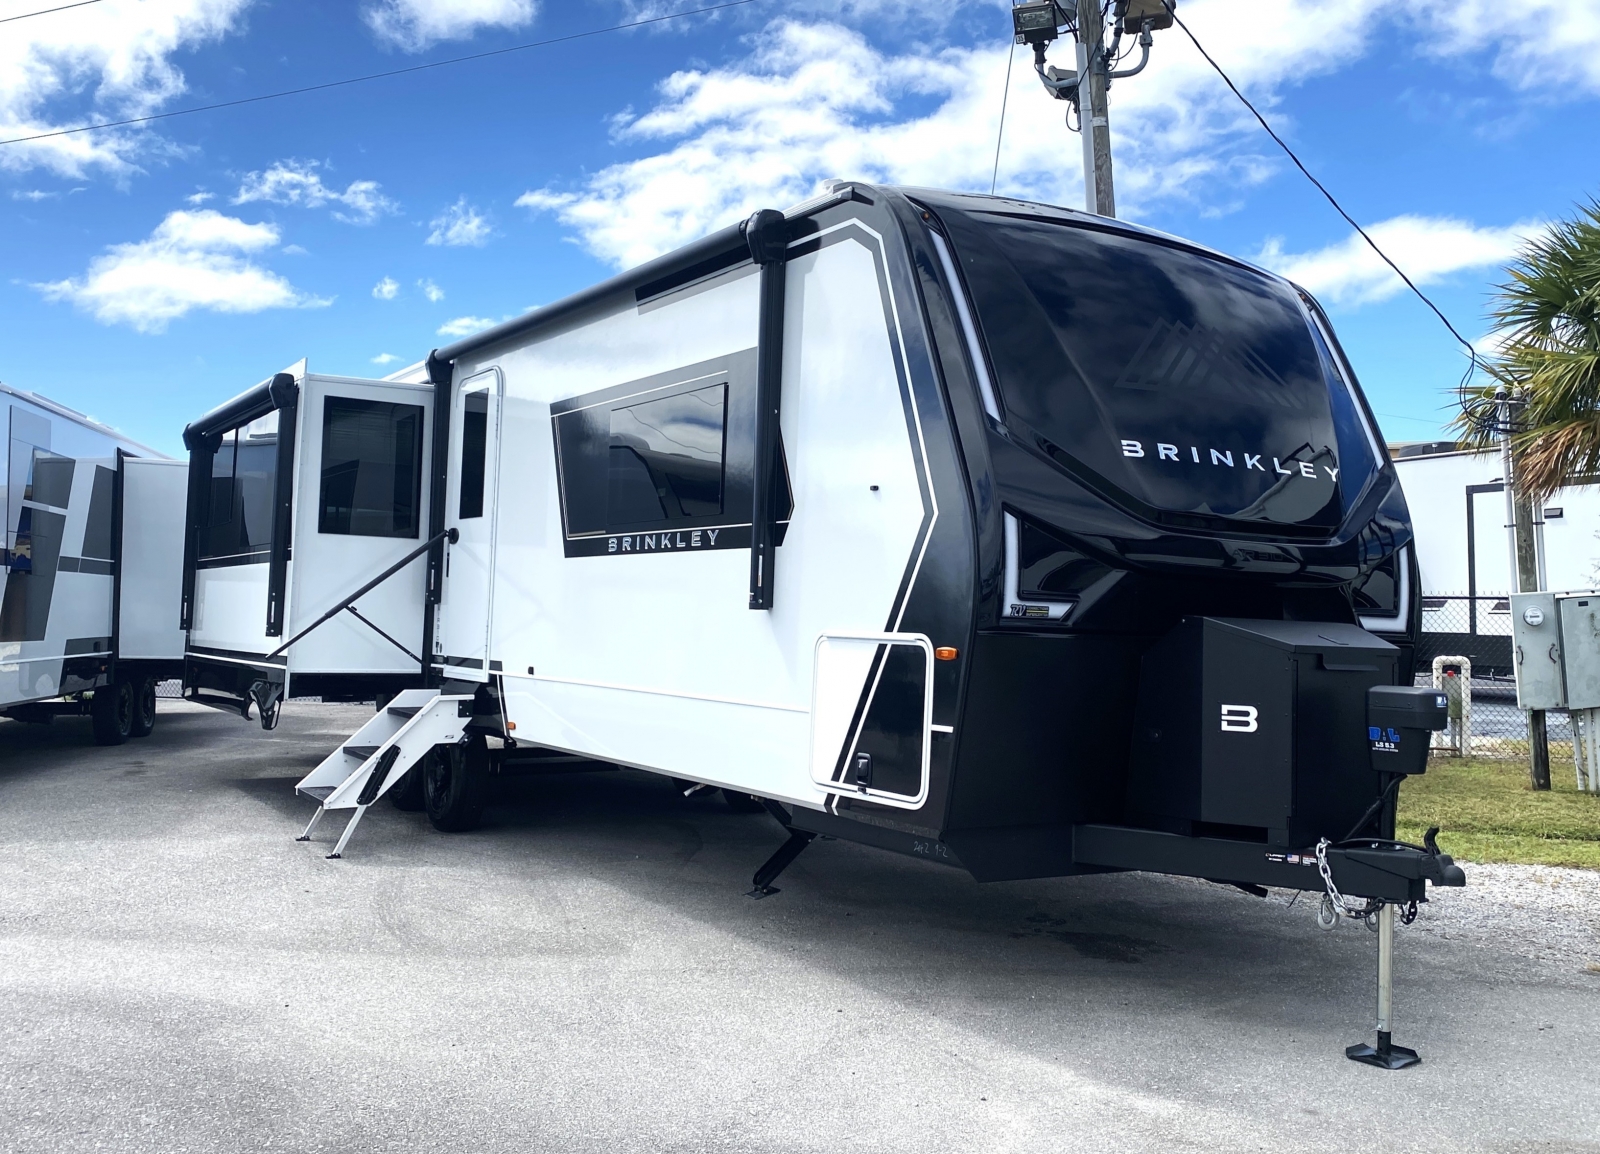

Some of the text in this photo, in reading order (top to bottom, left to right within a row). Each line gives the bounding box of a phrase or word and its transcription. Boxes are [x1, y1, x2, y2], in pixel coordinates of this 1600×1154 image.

[1120, 439, 1339, 482] BRINKLEY
[608, 529, 719, 552] BRINKLEY
[1010, 604, 1027, 617] RV
[1221, 704, 1258, 732] B
